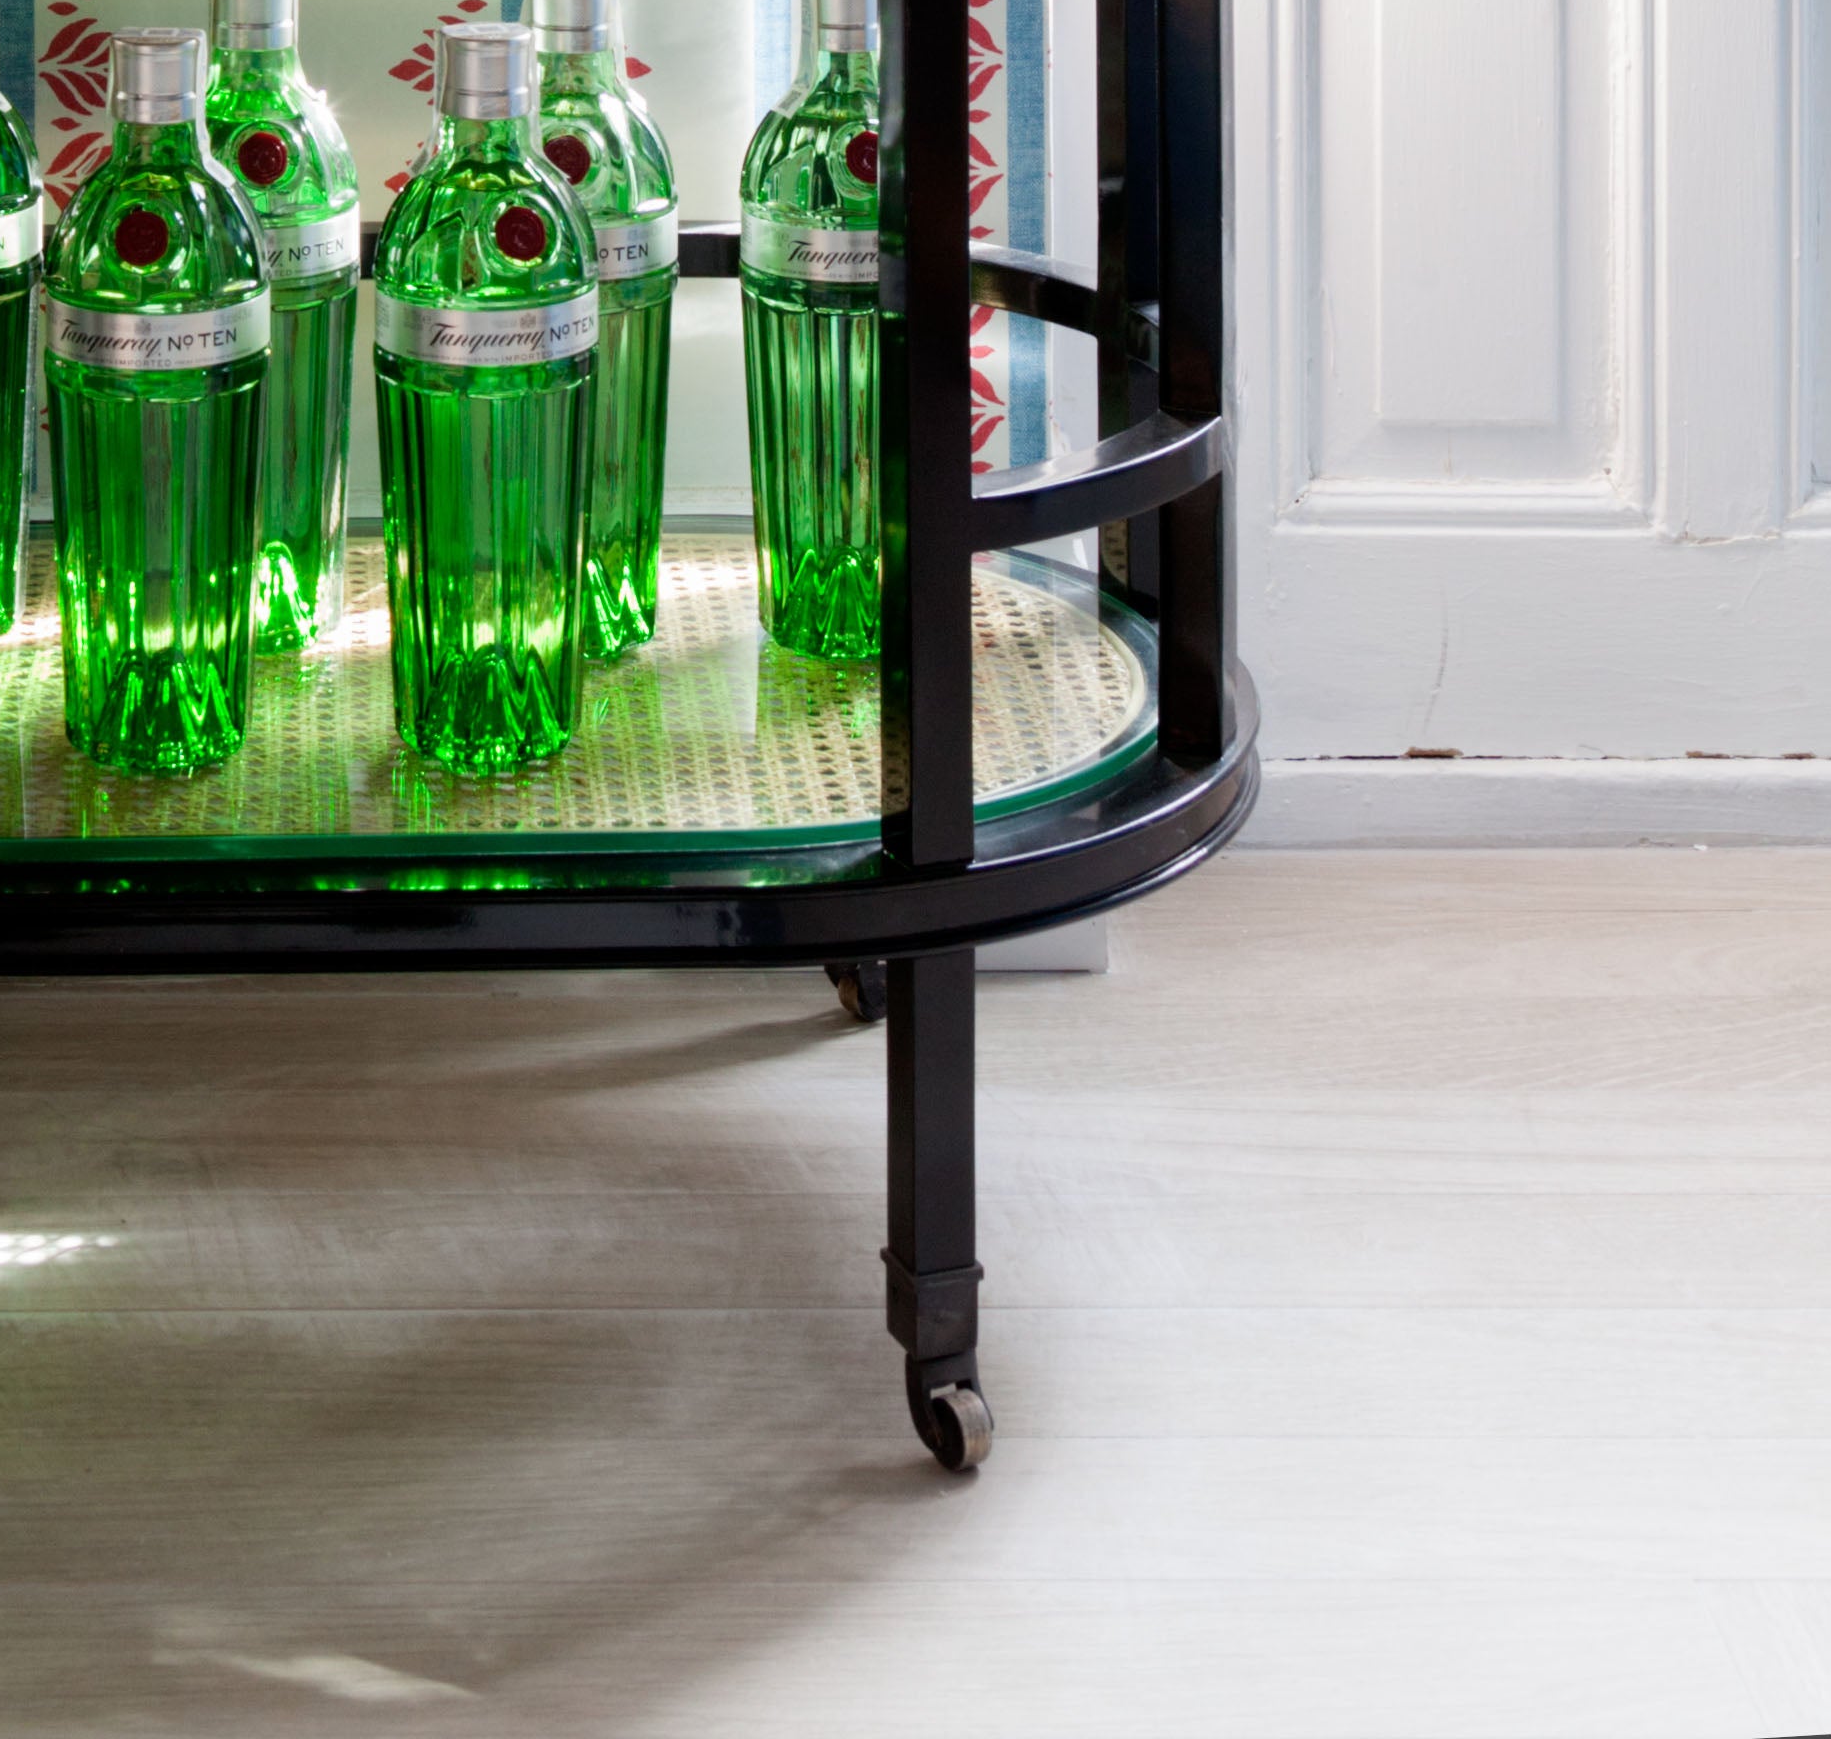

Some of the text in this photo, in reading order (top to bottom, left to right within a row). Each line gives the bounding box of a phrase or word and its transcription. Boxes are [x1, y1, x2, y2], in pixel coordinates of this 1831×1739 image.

[313, 239, 343, 257] TEN
[613, 242, 649, 261] TEN
[787, 240, 880, 270] Tanquera
[59, 318, 163, 357] Tanqueray
[199, 327, 237, 349] TEN
[429, 322, 546, 353] Tanqueray
[573, 317, 595, 337] TEN
